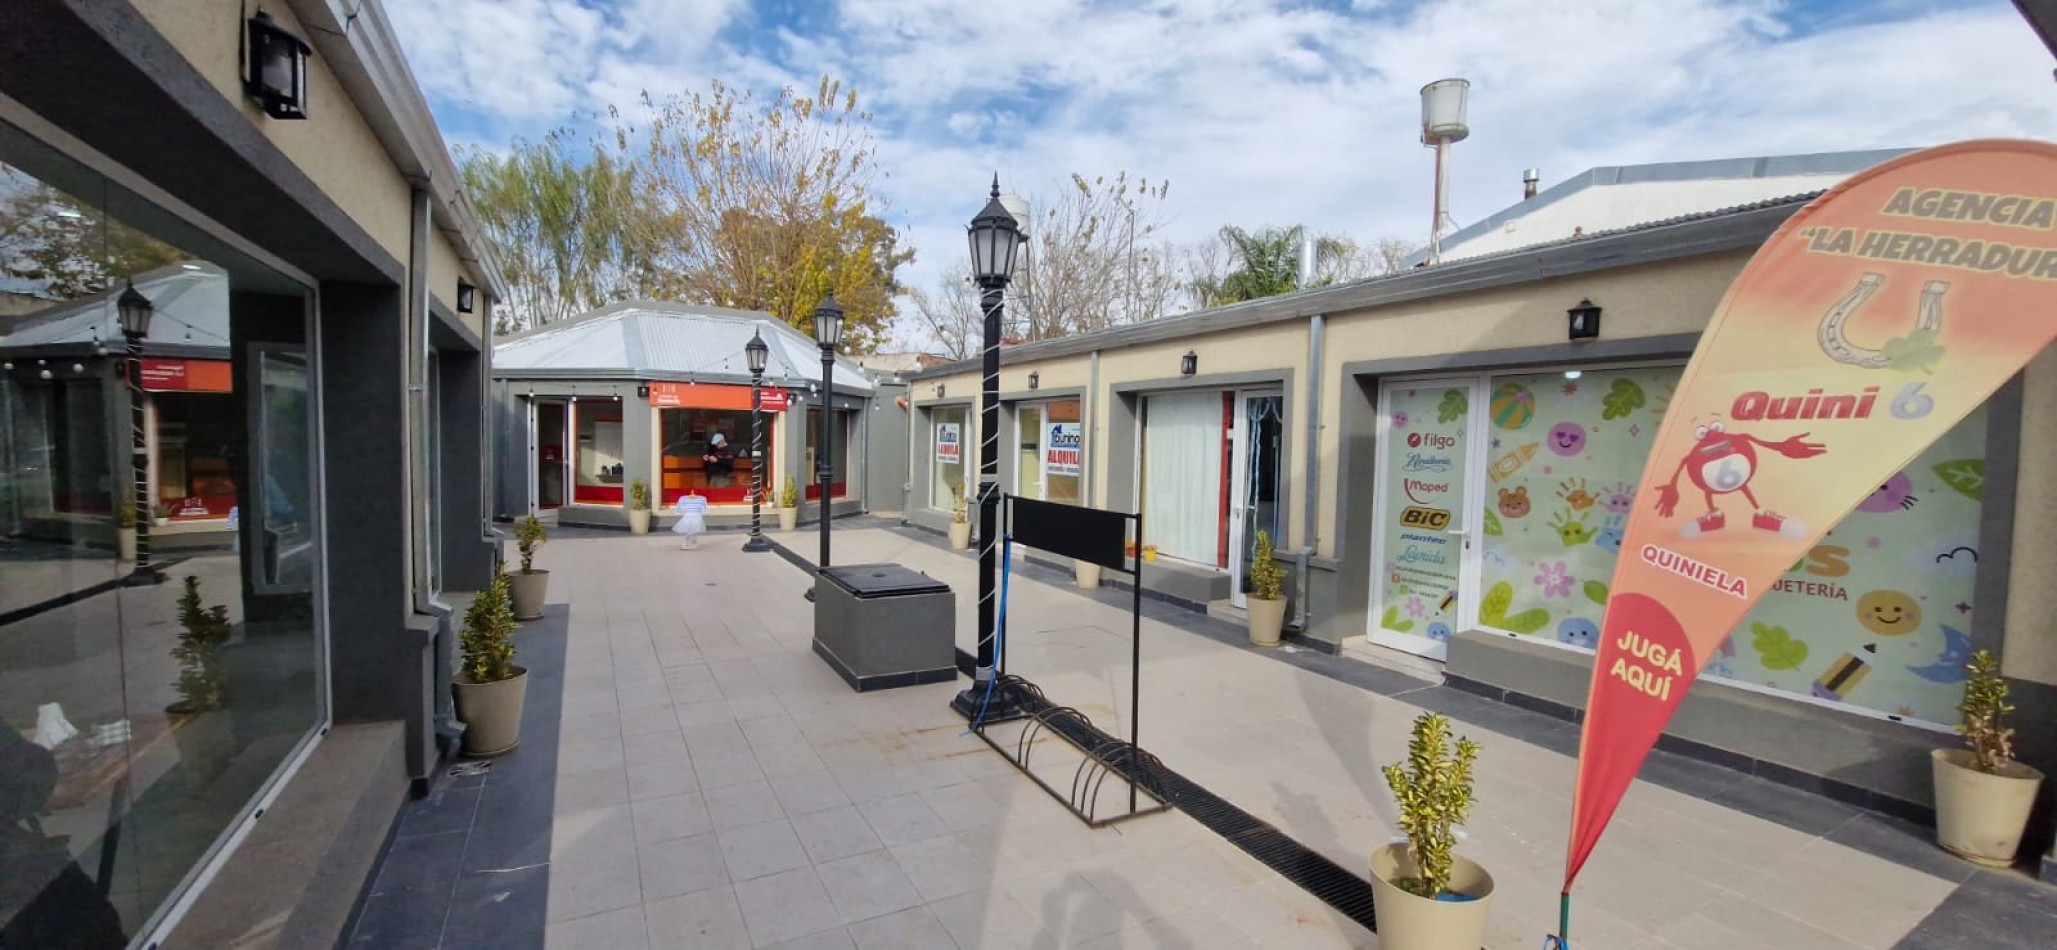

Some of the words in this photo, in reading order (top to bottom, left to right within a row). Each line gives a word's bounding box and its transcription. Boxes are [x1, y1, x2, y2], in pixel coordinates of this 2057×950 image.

[1882, 188, 2053, 229] AGENCIA
[1731, 387, 1880, 422] Quini
[1889, 381, 1935, 421] 6
[1424, 433, 1455, 450] filgo
[1405, 478, 1450, 495] Maped
[1641, 545, 1747, 598] QUINIELA
[1616, 631, 1683, 677] JUGÁ
[1610, 658, 1674, 702] AQUÍ
